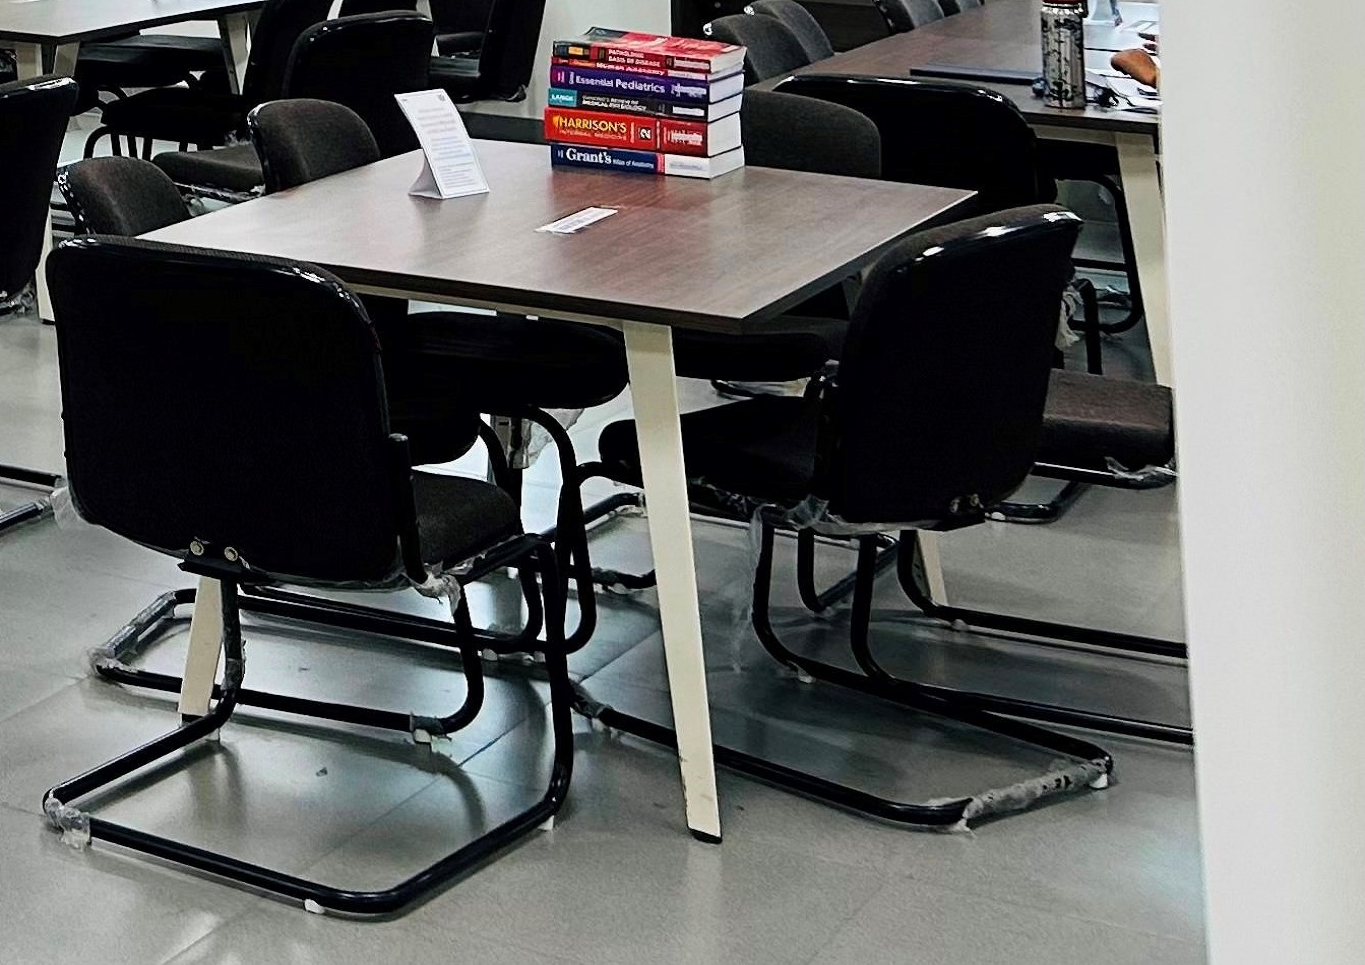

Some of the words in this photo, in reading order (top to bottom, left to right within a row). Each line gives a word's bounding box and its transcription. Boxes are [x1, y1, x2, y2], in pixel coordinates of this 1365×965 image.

[575, 74, 614, 88] Essential
[615, 78, 666, 94] Pediatrics
[550, 93, 575, 102] LANGE
[558, 115, 628, 134] HARRISON'S
[565, 147, 612, 165] Grant's
